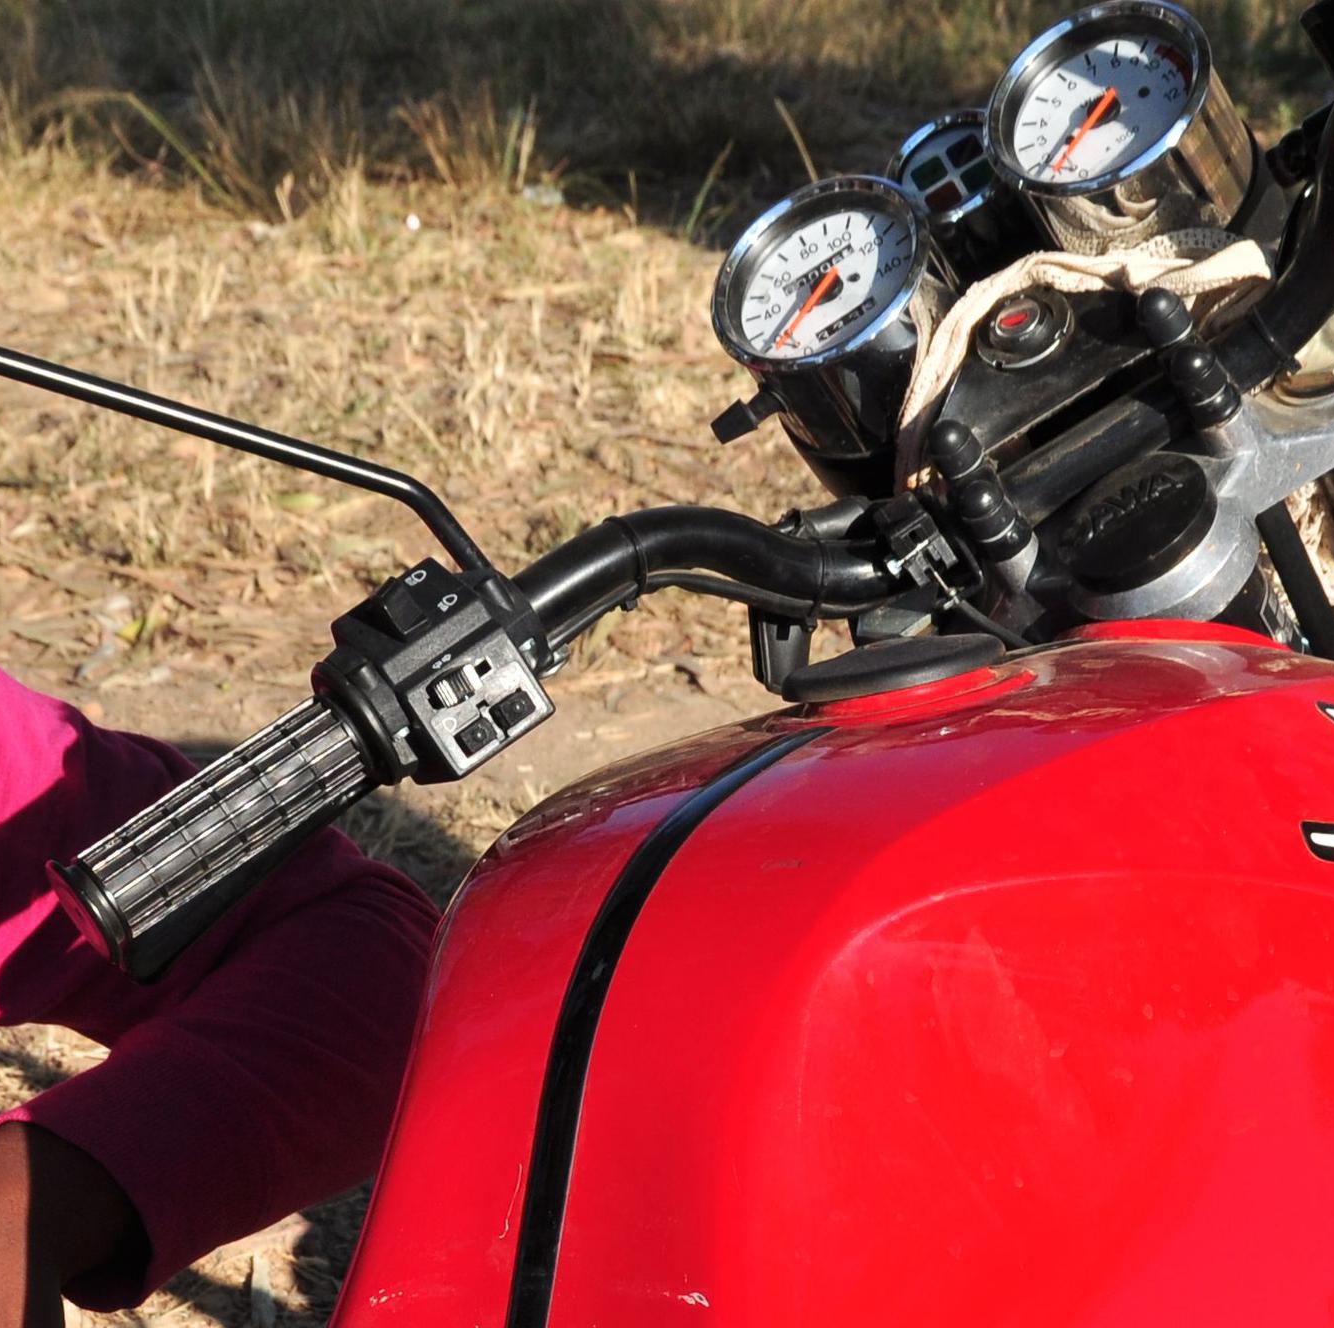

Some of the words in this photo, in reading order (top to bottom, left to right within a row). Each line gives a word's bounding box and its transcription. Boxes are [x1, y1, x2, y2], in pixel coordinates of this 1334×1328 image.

[1143, 58, 1161, 73] 10
[1163, 87, 1181, 103] 12
[1040, 117, 1048, 128] 4
[827, 230, 852, 250] 100
[859, 235, 884, 256] 120
[799, 242, 819, 260] 80
[877, 256, 902, 278] 140
[773, 271, 792, 288] 60
[764, 303, 782, 321] 40
